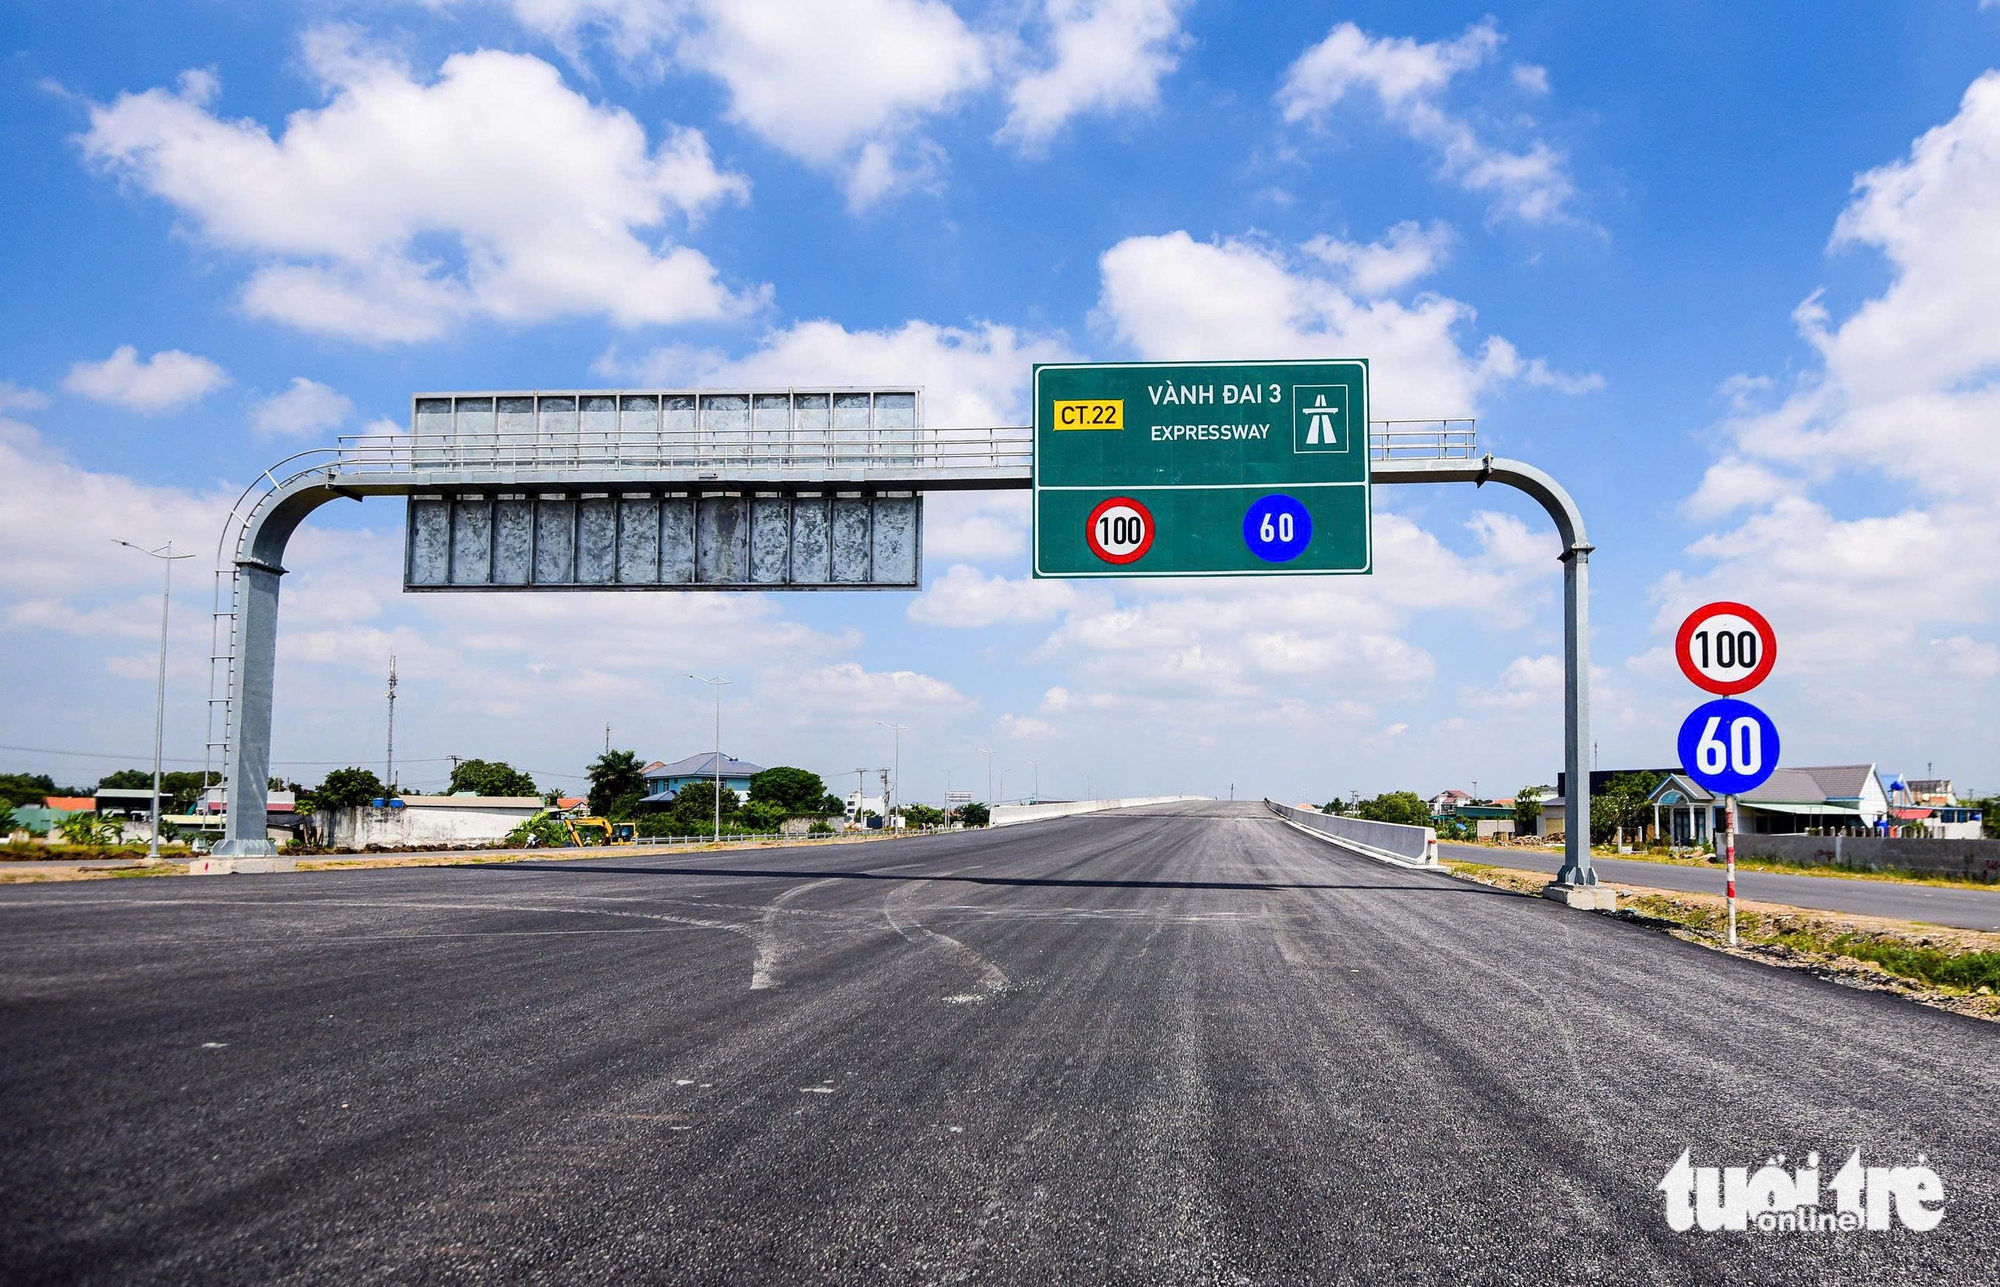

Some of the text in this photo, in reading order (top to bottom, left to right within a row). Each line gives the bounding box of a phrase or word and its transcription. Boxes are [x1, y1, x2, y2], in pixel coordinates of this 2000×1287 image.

[1148, 380, 1282, 405] VÀNH ĐAI 3
[1061, 405, 1117, 425] CT.22
[1151, 423, 1270, 441] EXPRESSWAY
[1099, 516, 1141, 546] 100
[1259, 512, 1294, 543] 60
[1695, 630, 1757, 668] 100
[1696, 716, 1762, 776] 60
